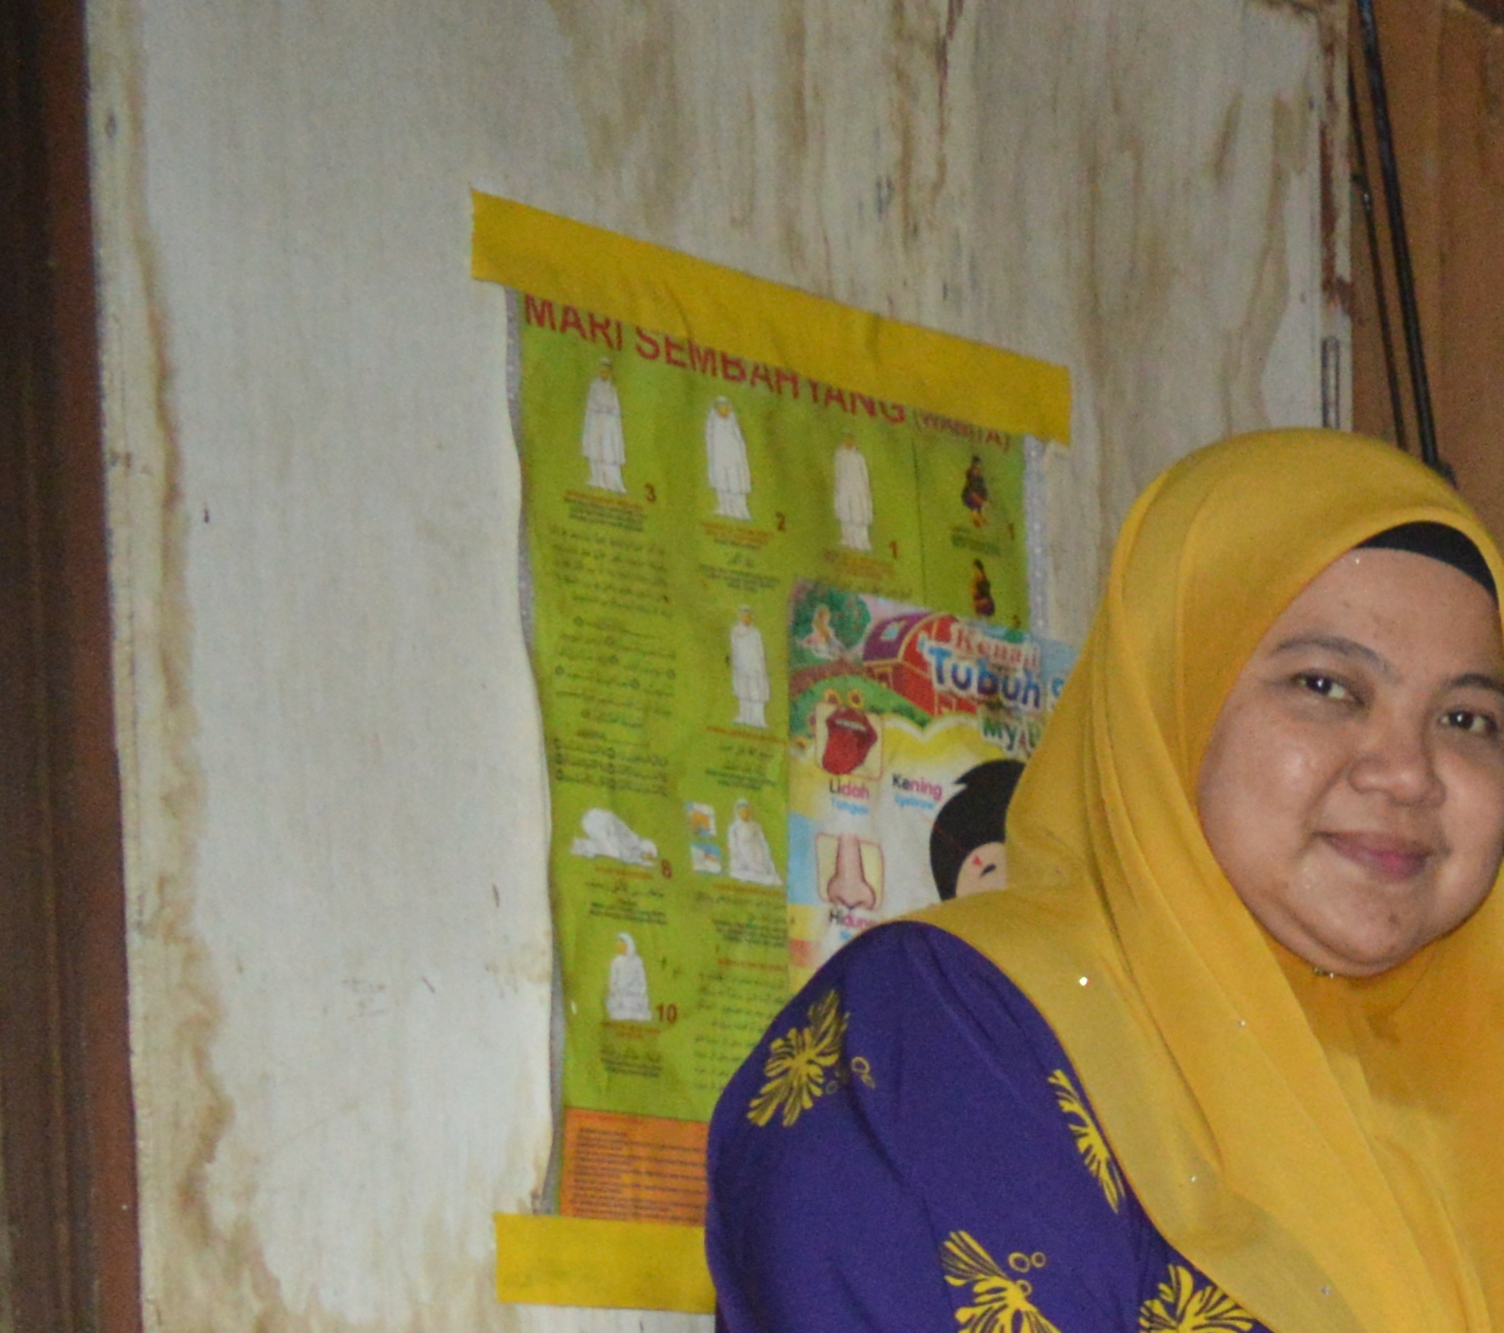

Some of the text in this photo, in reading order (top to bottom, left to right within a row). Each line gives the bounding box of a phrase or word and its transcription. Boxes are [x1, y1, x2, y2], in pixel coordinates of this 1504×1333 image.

[928, 646, 1040, 709] Tubuh
[829, 776, 869, 799] Lidah
[892, 773, 943, 801] Kening
[829, 908, 878, 929] Hidun
[656, 1003, 678, 1025] 10
